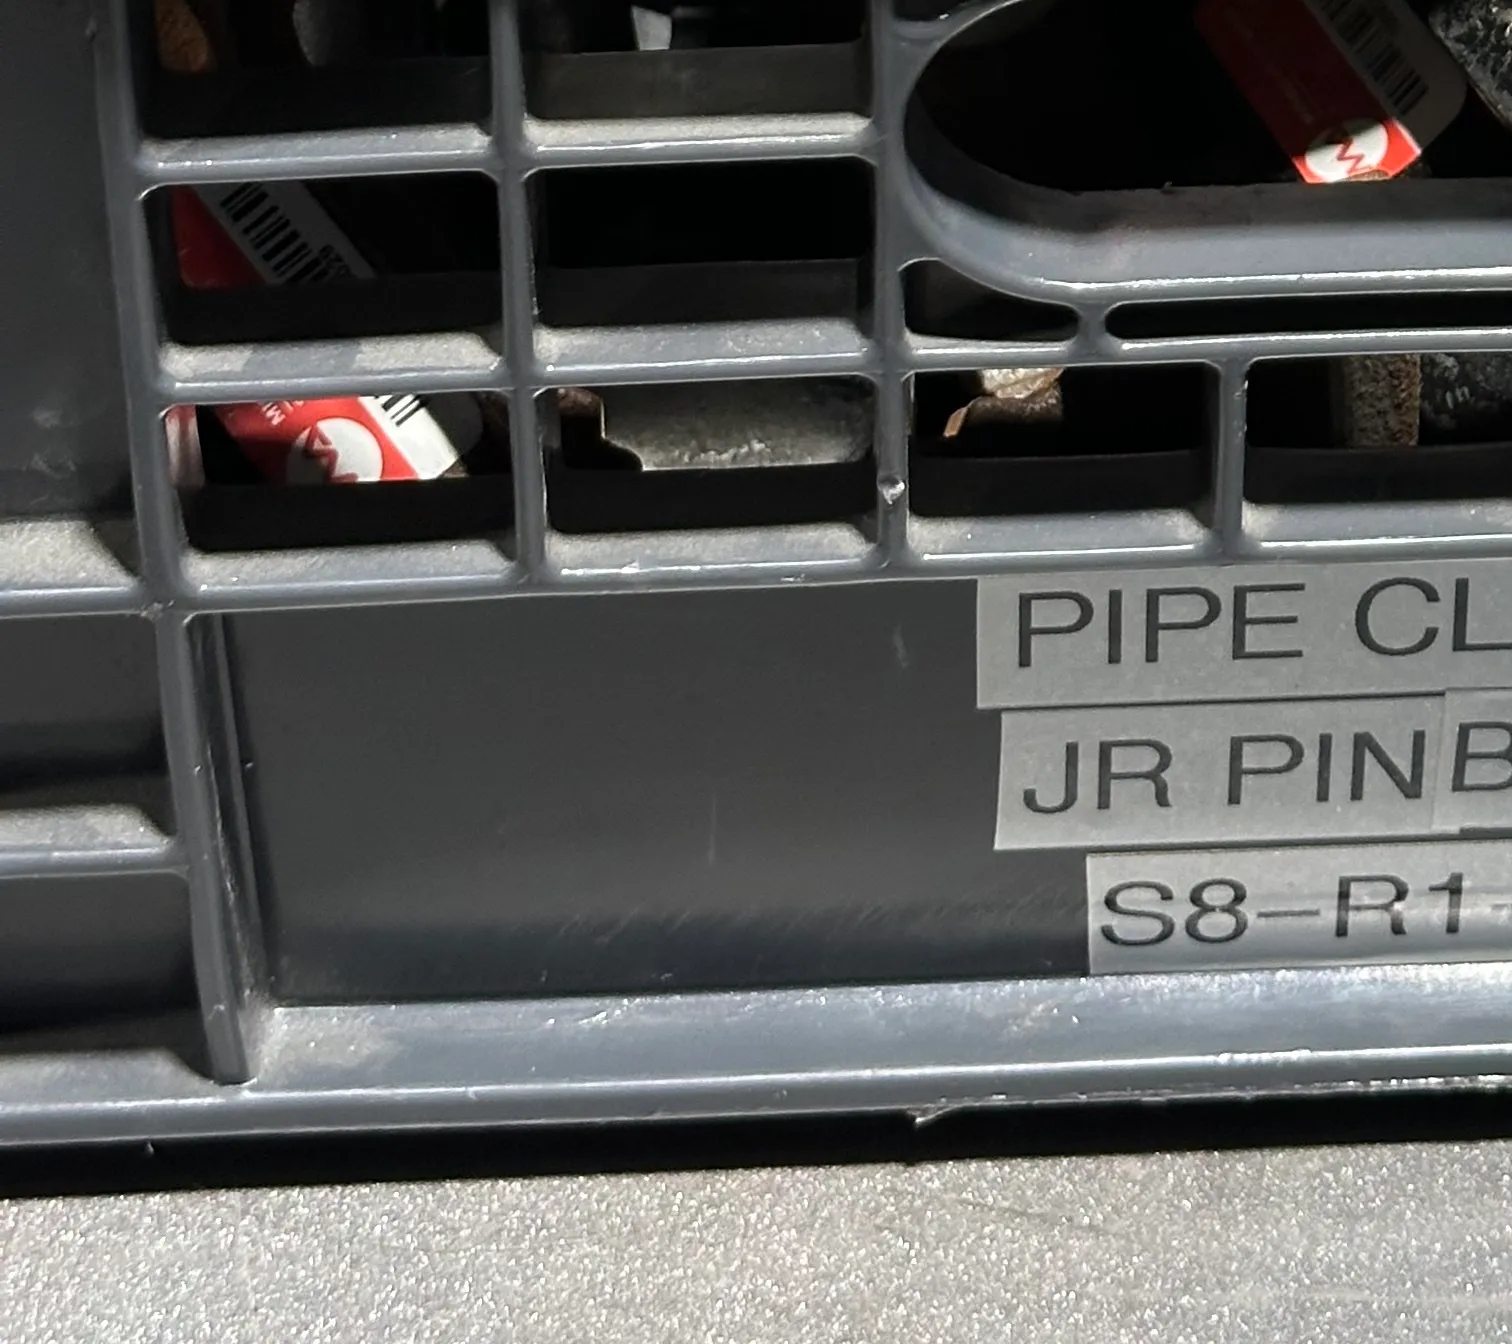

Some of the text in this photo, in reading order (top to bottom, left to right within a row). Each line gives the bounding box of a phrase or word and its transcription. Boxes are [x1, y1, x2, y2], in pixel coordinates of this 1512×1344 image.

[1018, 583, 1305, 668] PIPE
[1023, 728, 1427, 816] JR PIN
